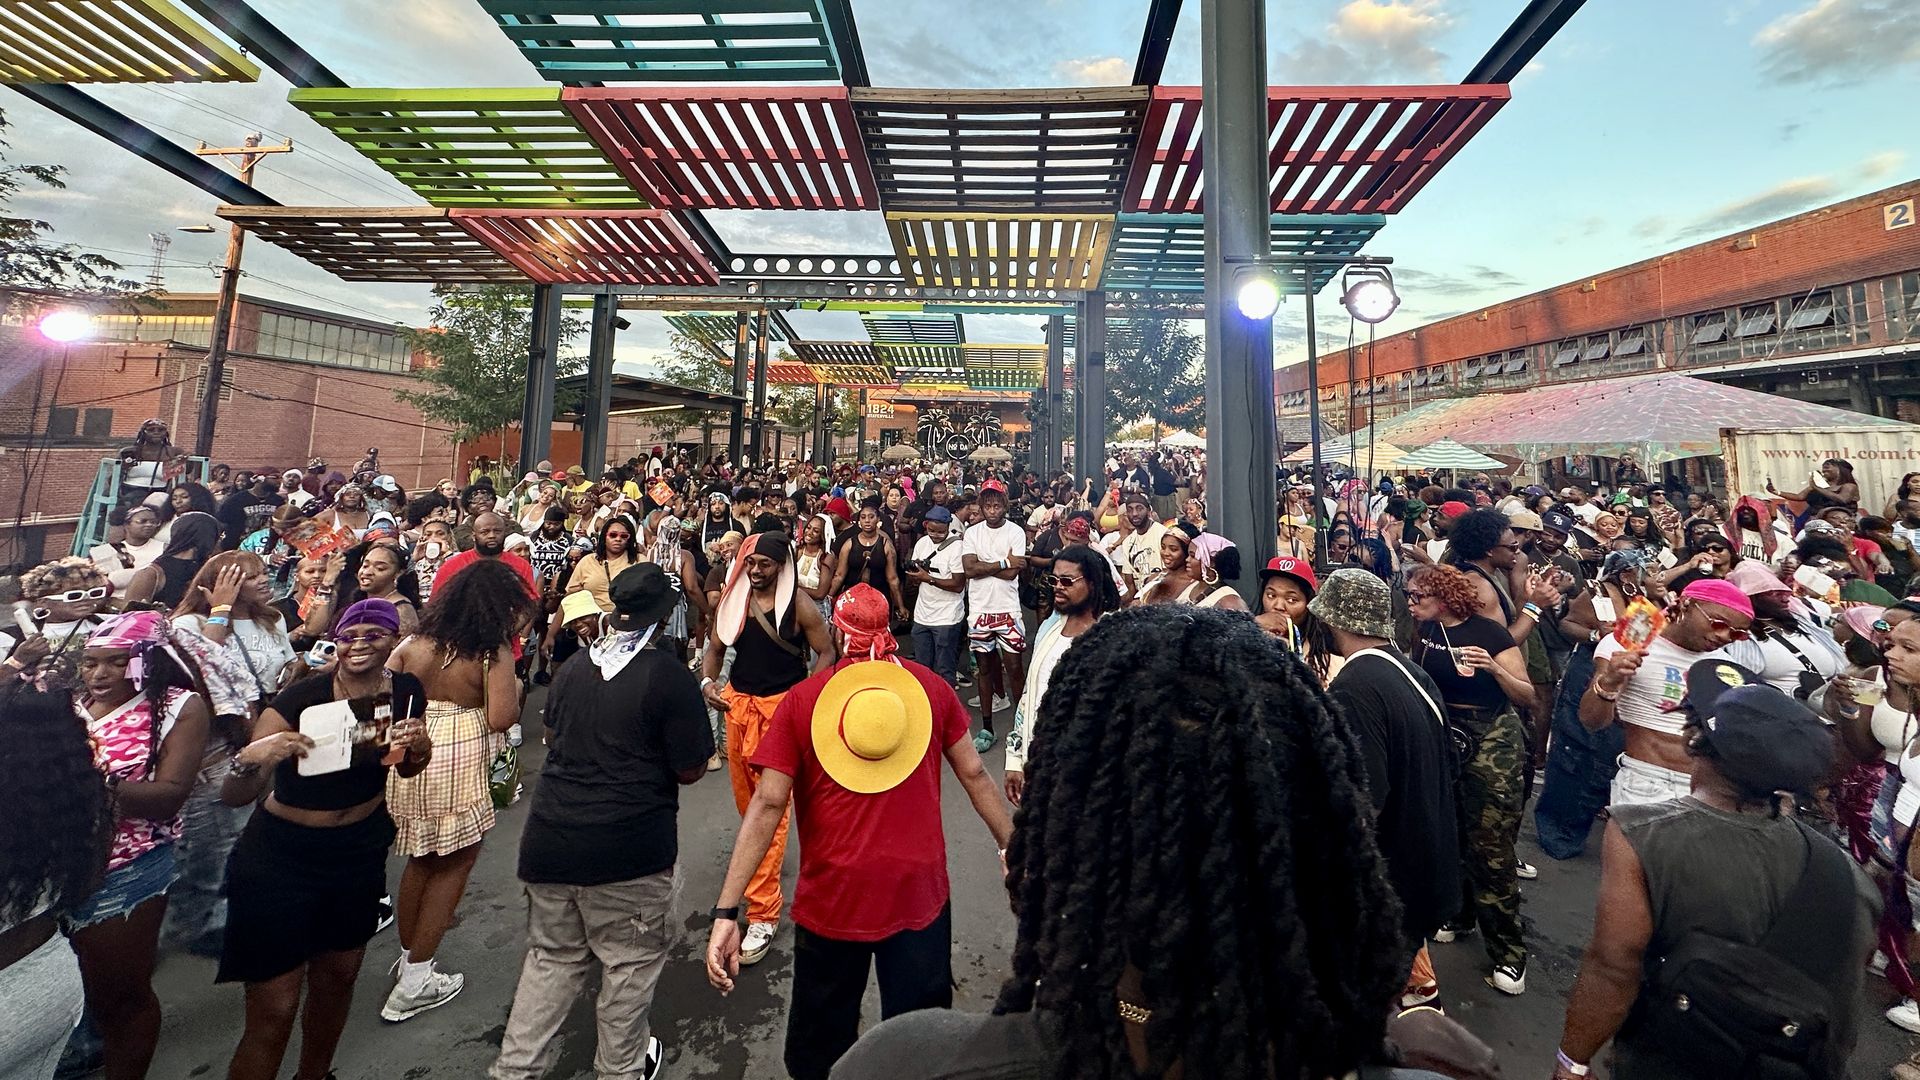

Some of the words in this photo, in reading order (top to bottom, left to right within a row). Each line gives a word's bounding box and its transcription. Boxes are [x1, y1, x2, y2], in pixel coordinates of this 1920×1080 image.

[1889, 204, 1910, 227] 2
[867, 403, 895, 414] 1824
[1279, 559, 1296, 571] W
